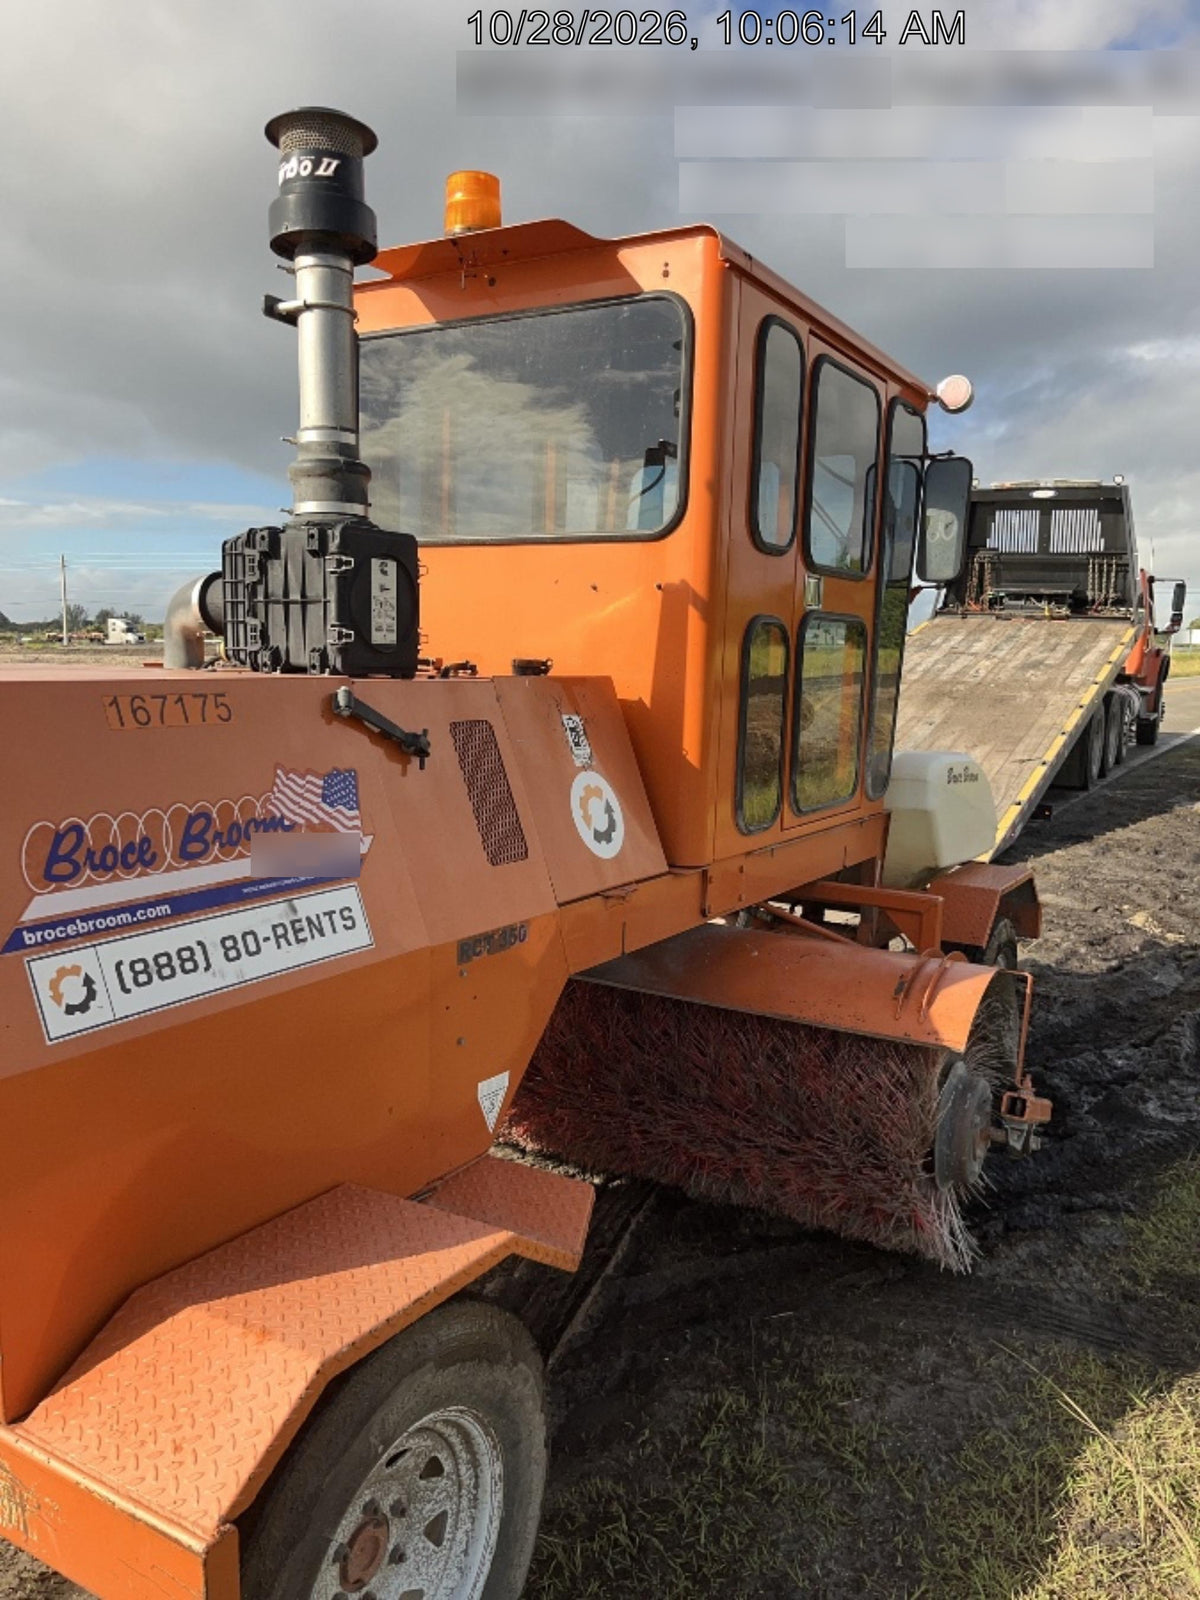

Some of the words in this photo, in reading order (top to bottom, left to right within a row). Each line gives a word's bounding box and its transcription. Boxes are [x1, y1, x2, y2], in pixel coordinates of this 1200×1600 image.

[108, 692, 232, 728] 167175
[43, 824, 158, 883] Broce
[22, 903, 172, 945] brocebroom.com
[114, 939, 213, 995] (888)
[219, 905, 357, 963] 80-RENTS
